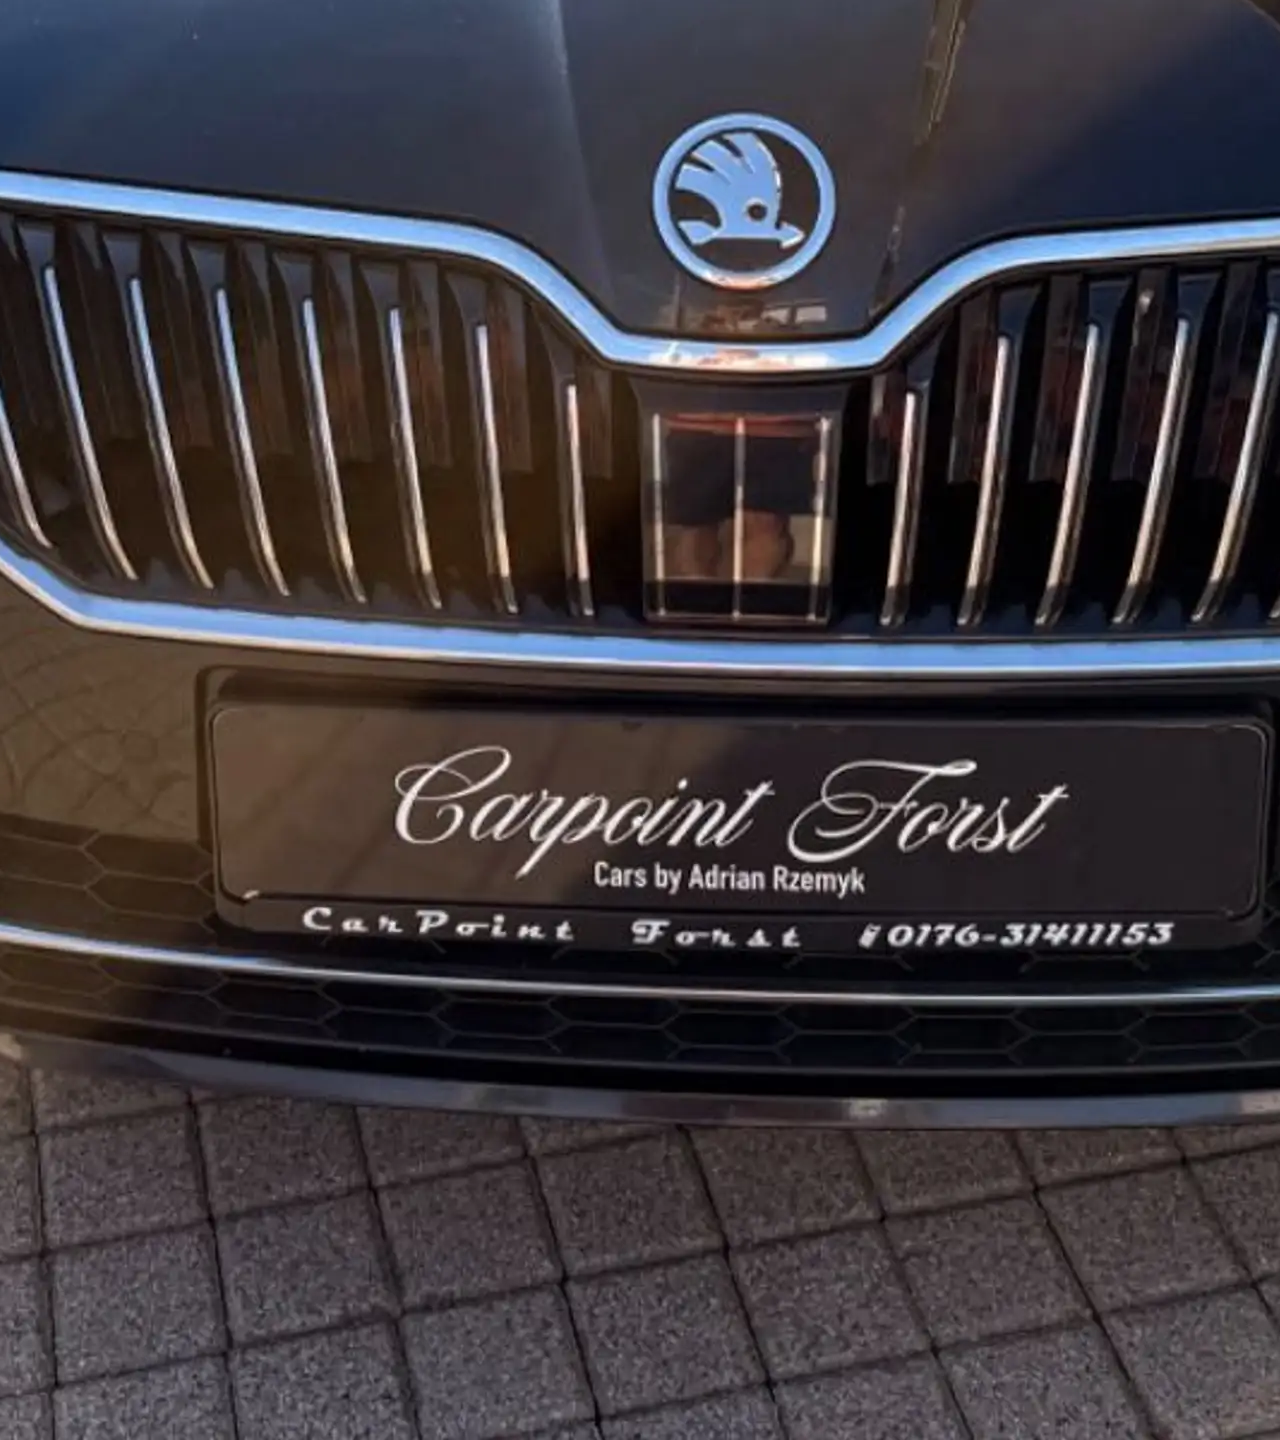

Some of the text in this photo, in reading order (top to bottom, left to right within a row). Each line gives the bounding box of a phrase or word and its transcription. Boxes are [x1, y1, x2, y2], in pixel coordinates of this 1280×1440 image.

[393, 745, 1069, 880] Carpoint Forst
[593, 860, 866, 900] Cars by Adrian Rzemyk
[302, 906, 574, 941] CarPoint
[631, 918, 800, 948] Forst
